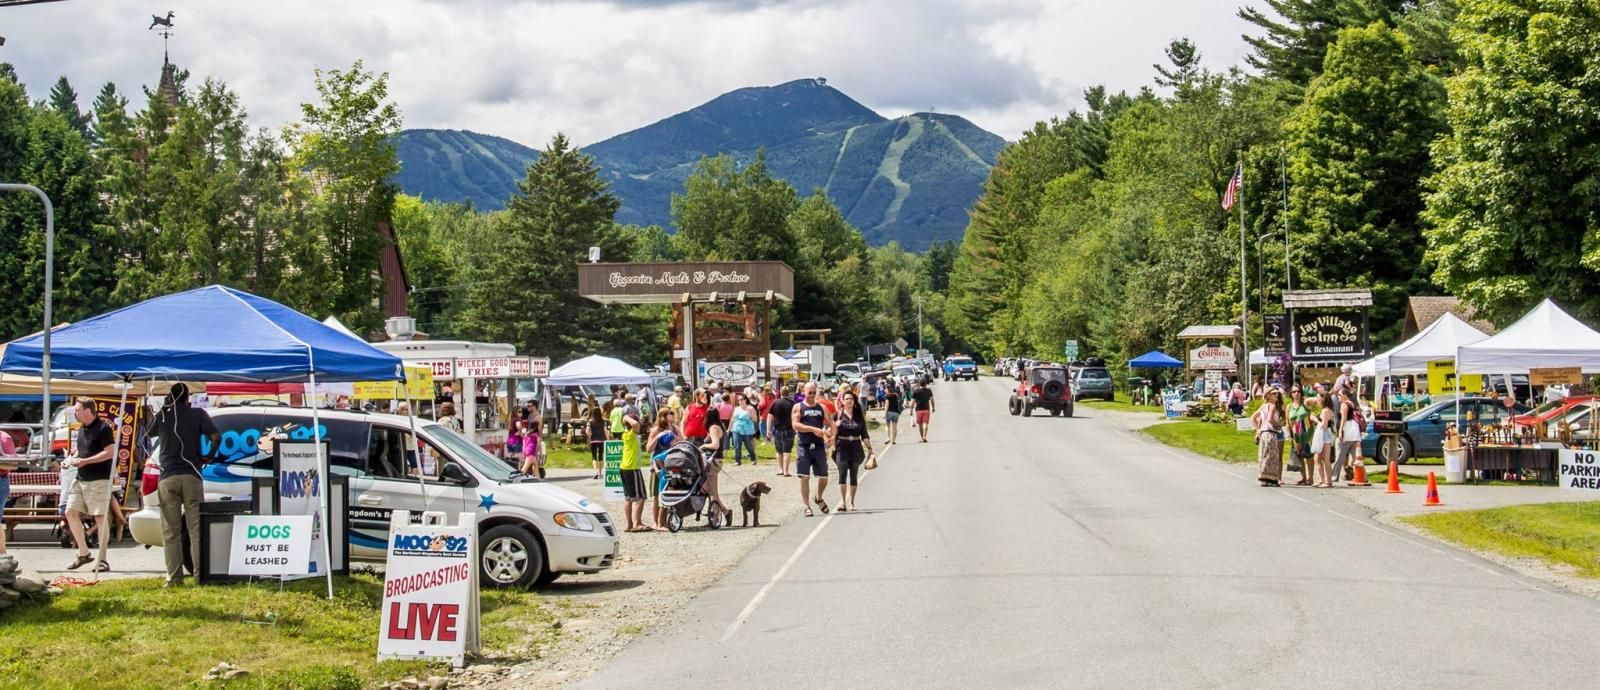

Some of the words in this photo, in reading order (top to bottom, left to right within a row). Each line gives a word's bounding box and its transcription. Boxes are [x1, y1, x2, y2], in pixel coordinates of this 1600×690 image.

[1299, 320, 1318, 336] Jay
[1316, 315, 1358, 335] Village
[1317, 331, 1339, 344] Inn
[1305, 346, 1312, 354] &
[1313, 345, 1354, 353] Restaurant
[457, 359, 486, 368] WICKED
[490, 358, 509, 367] GOOD
[467, 367, 499, 376] FRIES
[1575, 453, 1595, 465] NO
[247, 524, 291, 540] DOGS
[246, 544, 271, 552] MUST
[277, 544, 290, 552] BE
[393, 534, 430, 551] MOO
[446, 535, 468, 552] 92
[244, 556, 289, 566] LEASHED
[386, 562, 469, 599] BROADCASTING
[387, 601, 460, 642] LIVE
